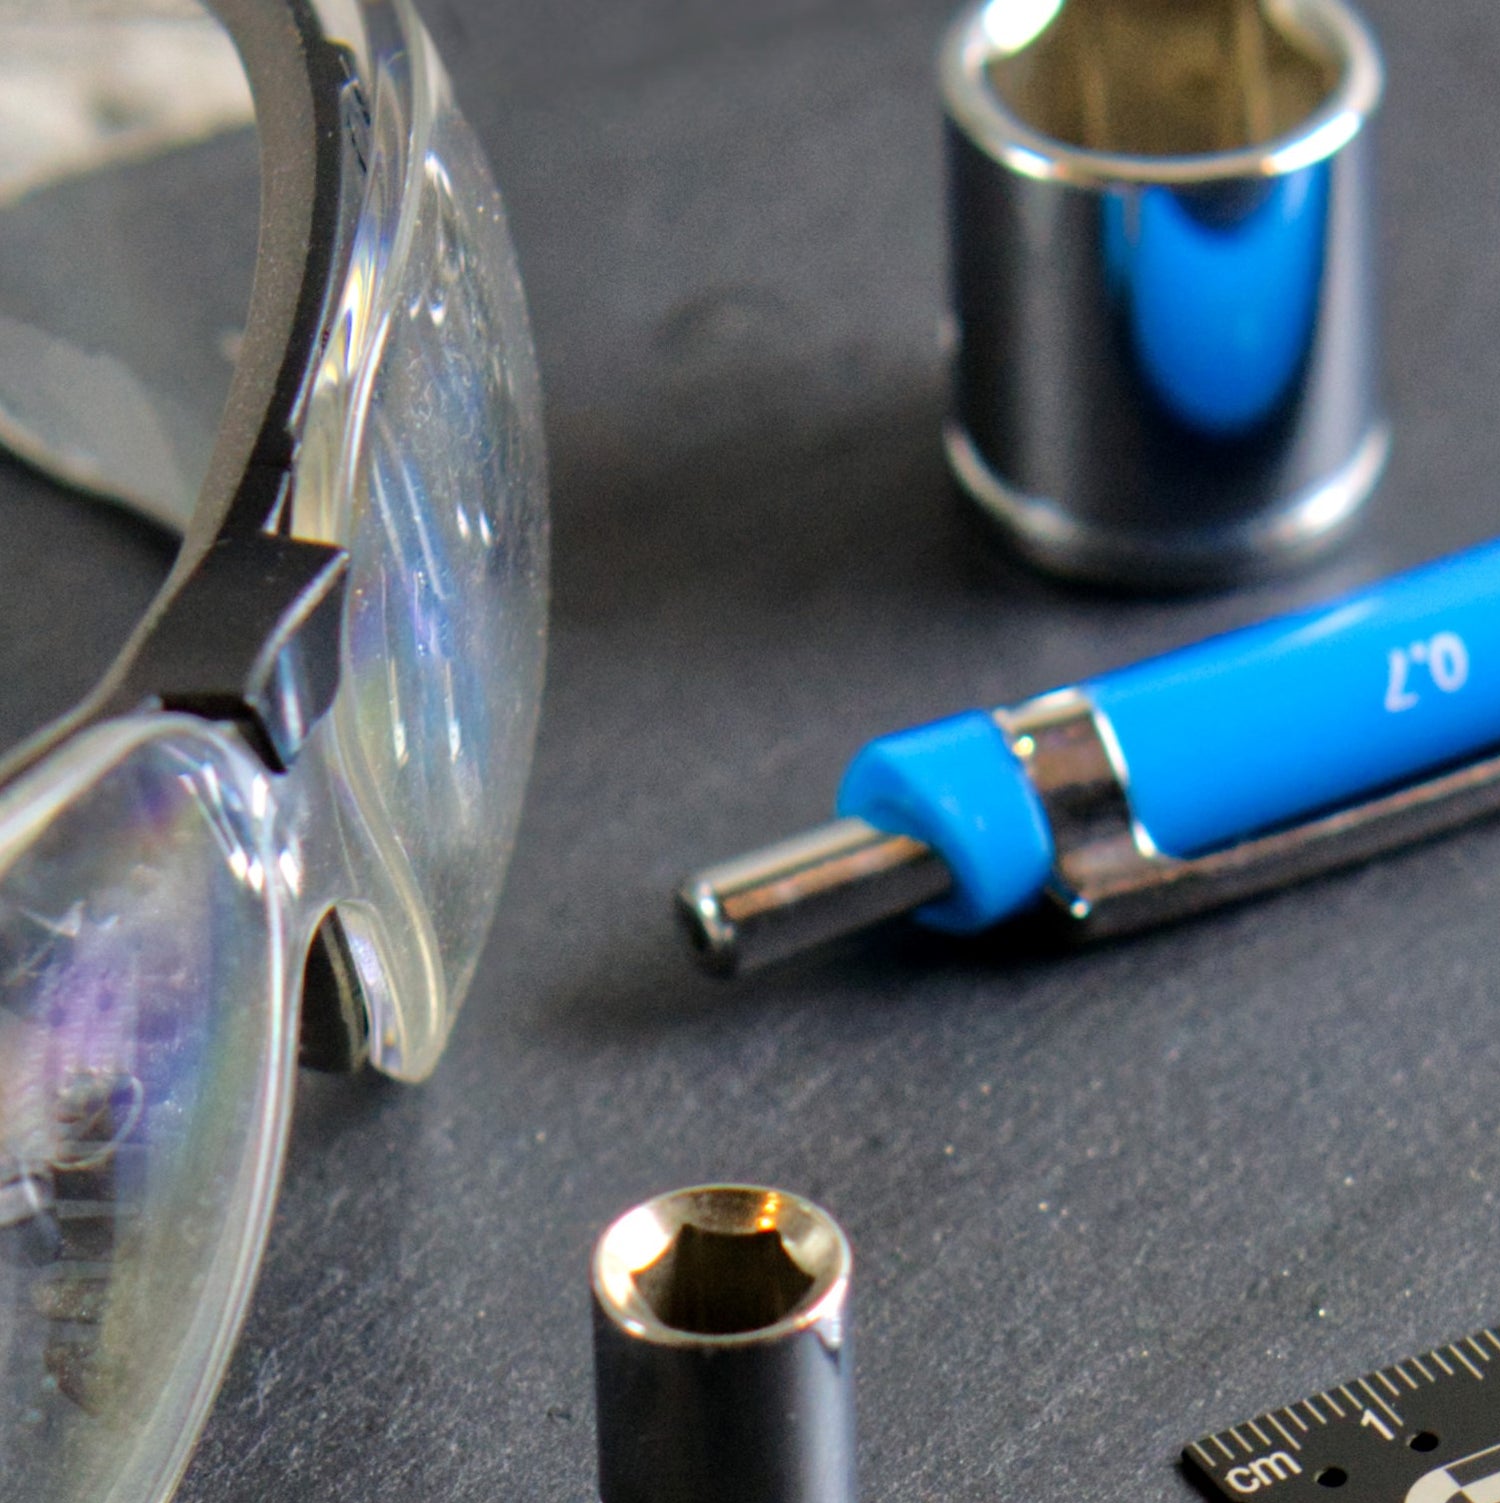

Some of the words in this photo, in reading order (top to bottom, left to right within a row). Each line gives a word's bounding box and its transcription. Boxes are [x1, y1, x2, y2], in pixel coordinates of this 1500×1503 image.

[1383, 632, 1468, 713] 0.7
[1225, 1451, 1303, 1493] cm
[1360, 1408, 1395, 1441] 1
